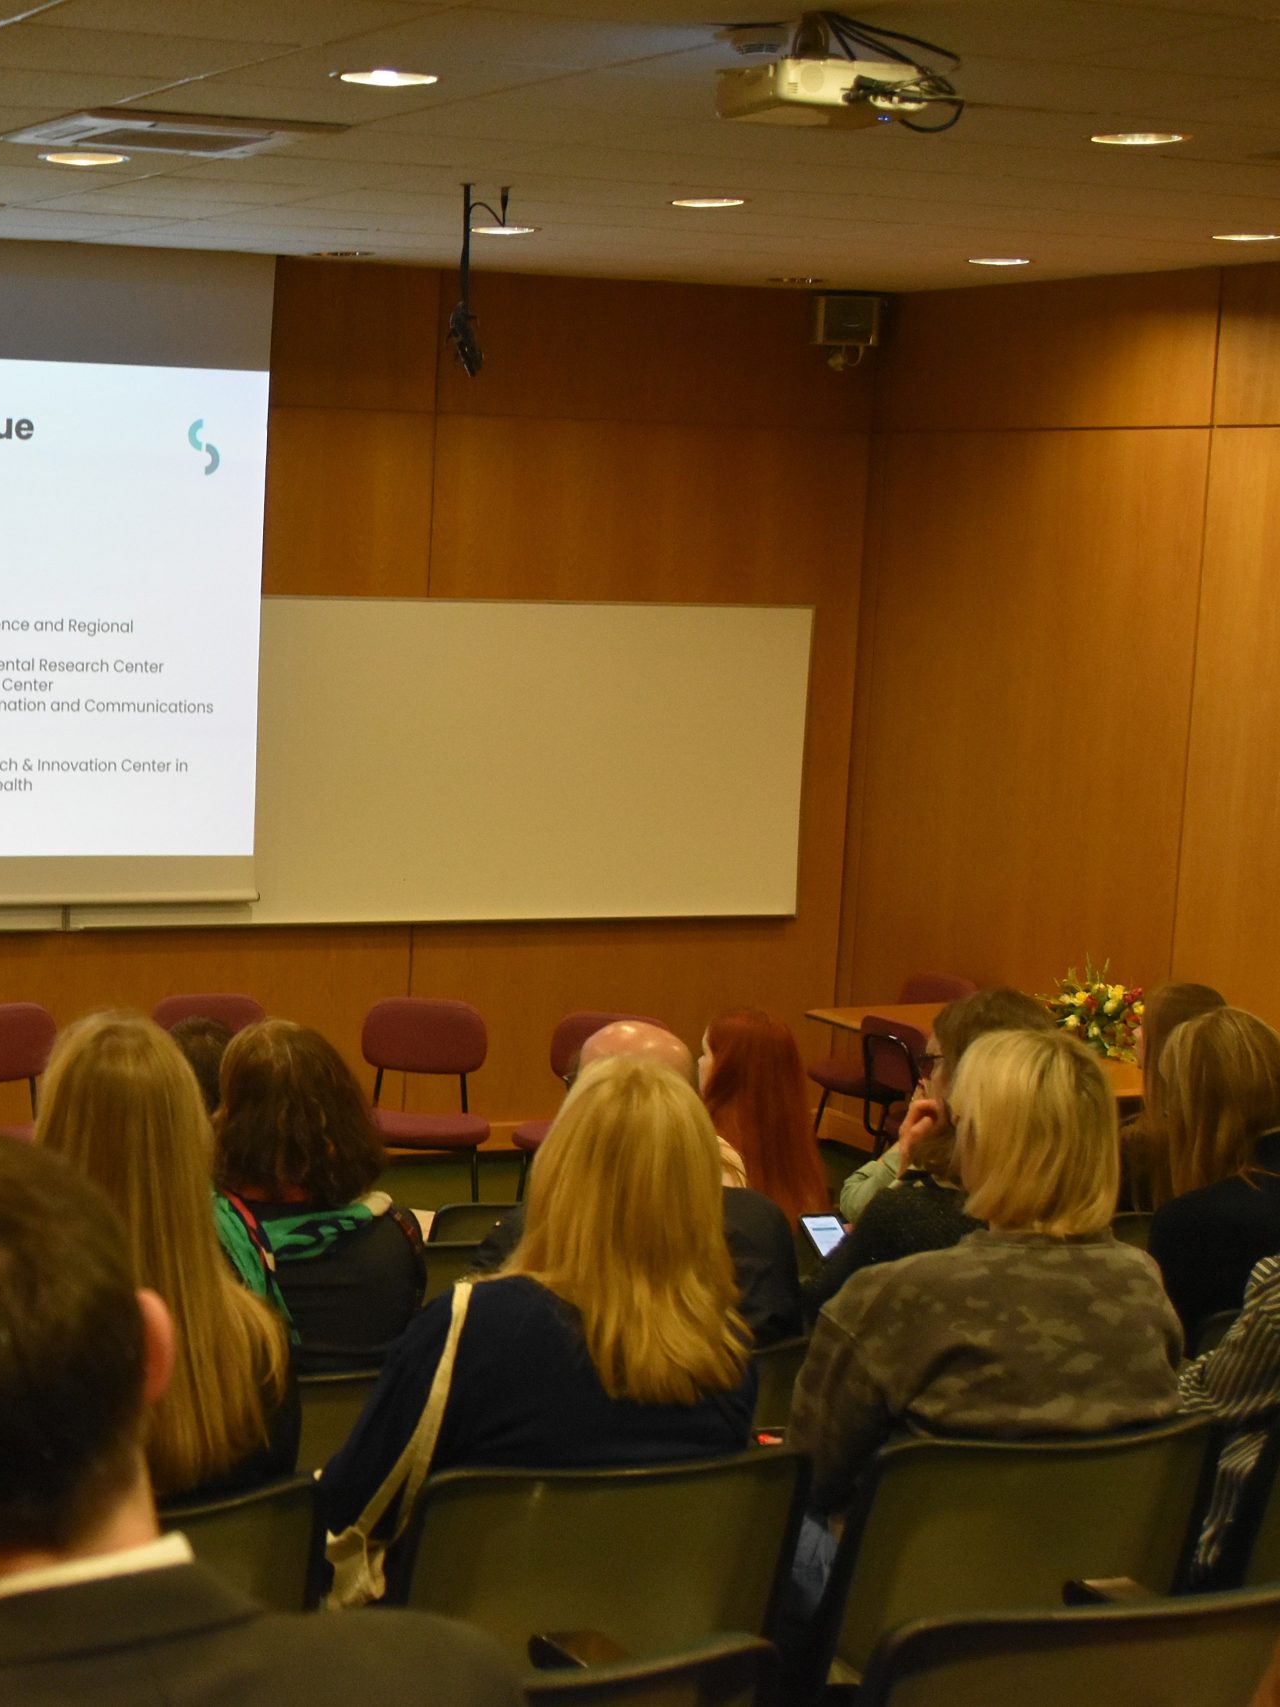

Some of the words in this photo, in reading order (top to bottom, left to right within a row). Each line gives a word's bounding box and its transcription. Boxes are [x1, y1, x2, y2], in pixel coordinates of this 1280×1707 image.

[34, 618, 64, 632] and
[69, 619, 133, 637] Regional
[39, 659, 109, 672] Research
[114, 660, 164, 673] Center
[2, 678, 53, 692] Center
[51, 698, 80, 712] and
[85, 699, 213, 713] Communications
[22, 758, 33, 771] &
[38, 758, 116, 772] Innovation
[121, 759, 171, 772] Center
[176, 759, 188, 772] in
